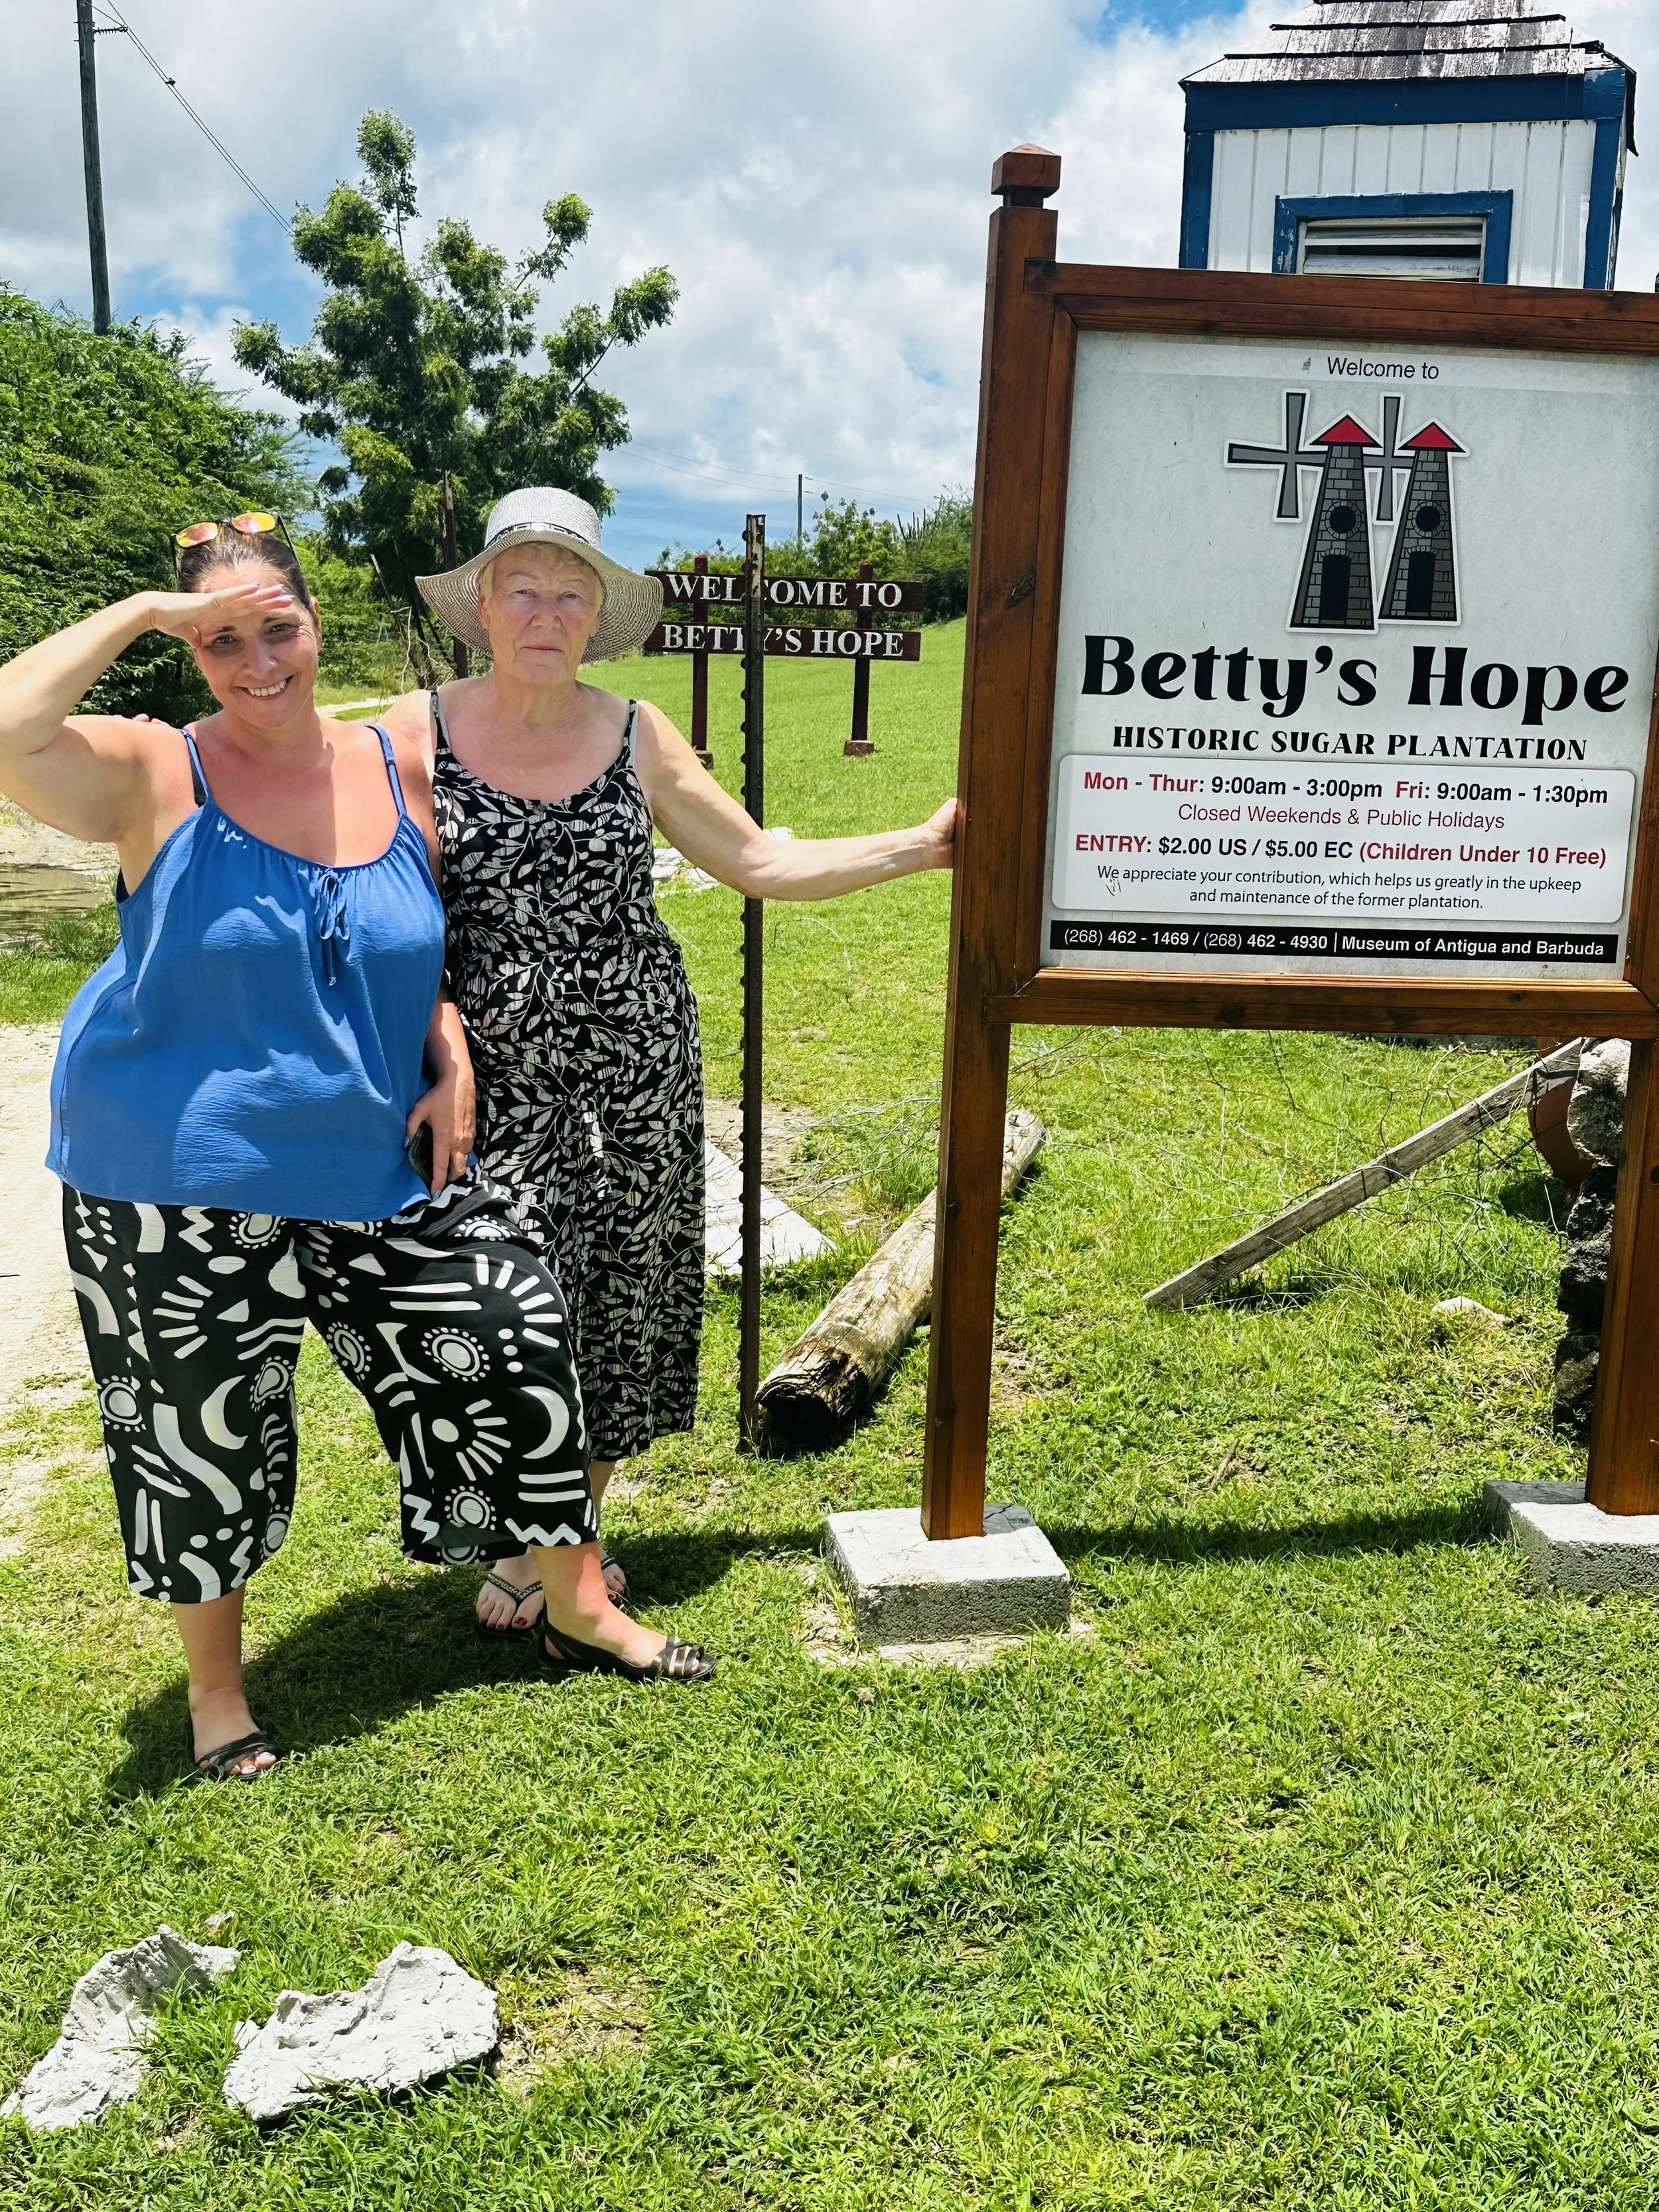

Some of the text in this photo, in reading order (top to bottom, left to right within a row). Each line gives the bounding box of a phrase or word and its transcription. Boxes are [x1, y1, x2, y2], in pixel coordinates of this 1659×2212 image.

[1328, 357, 1439, 379] Welcome to
[666, 574, 902, 607] WELOME TO
[811, 629, 904, 657] HOPE
[1082, 635, 1628, 725] Betty’s Hope
[1114, 727, 1587, 760] HISTORIC SUGAR PLANTATION
[1085, 772, 1127, 790] Mon
[1149, 774, 1204, 792] Thur:
[1212, 776, 1285, 794] 9:00am
[1307, 779, 1382, 801] 3:00pm
[1396, 781, 1429, 798] Fri:
[1437, 782, 1511, 800] 9:00am
[1534, 785, 1607, 807] 1:30pm
[1179, 804, 1504, 832] Closed Weekends & Public Holidays
[1076, 835, 1151, 852] ENTRY:
[1159, 836, 1211, 855] $2.00
[1219, 839, 1246, 855] US
[1265, 839, 1317, 858] $5.00
[1325, 842, 1352, 858] EC
[1360, 842, 1451, 863] (Children
[1460, 845, 1520, 862] Under
[1528, 848, 1548, 863] 10
[1556, 848, 1605, 869] Free)
[1098, 865, 1581, 893] We appreciate your contribution, which helps us greatly in the upkeep
[1190, 889, 1482, 909] and maintenance of the former plantation.
[1065, 929, 1102, 946] (268)
[1108, 930, 1136, 943] 462
[1153, 932, 1189, 945] 1469
[1204, 933, 1242, 949] (268)
[1248, 934, 1275, 947] 462
[1291, 936, 1327, 948] 4930
[1342, 936, 1409, 950] Museum
[1415, 938, 1431, 951] of
[1435, 939, 1496, 956] Antigua
[1502, 941, 1531, 954] and
[1537, 941, 1603, 955] Barbuda
